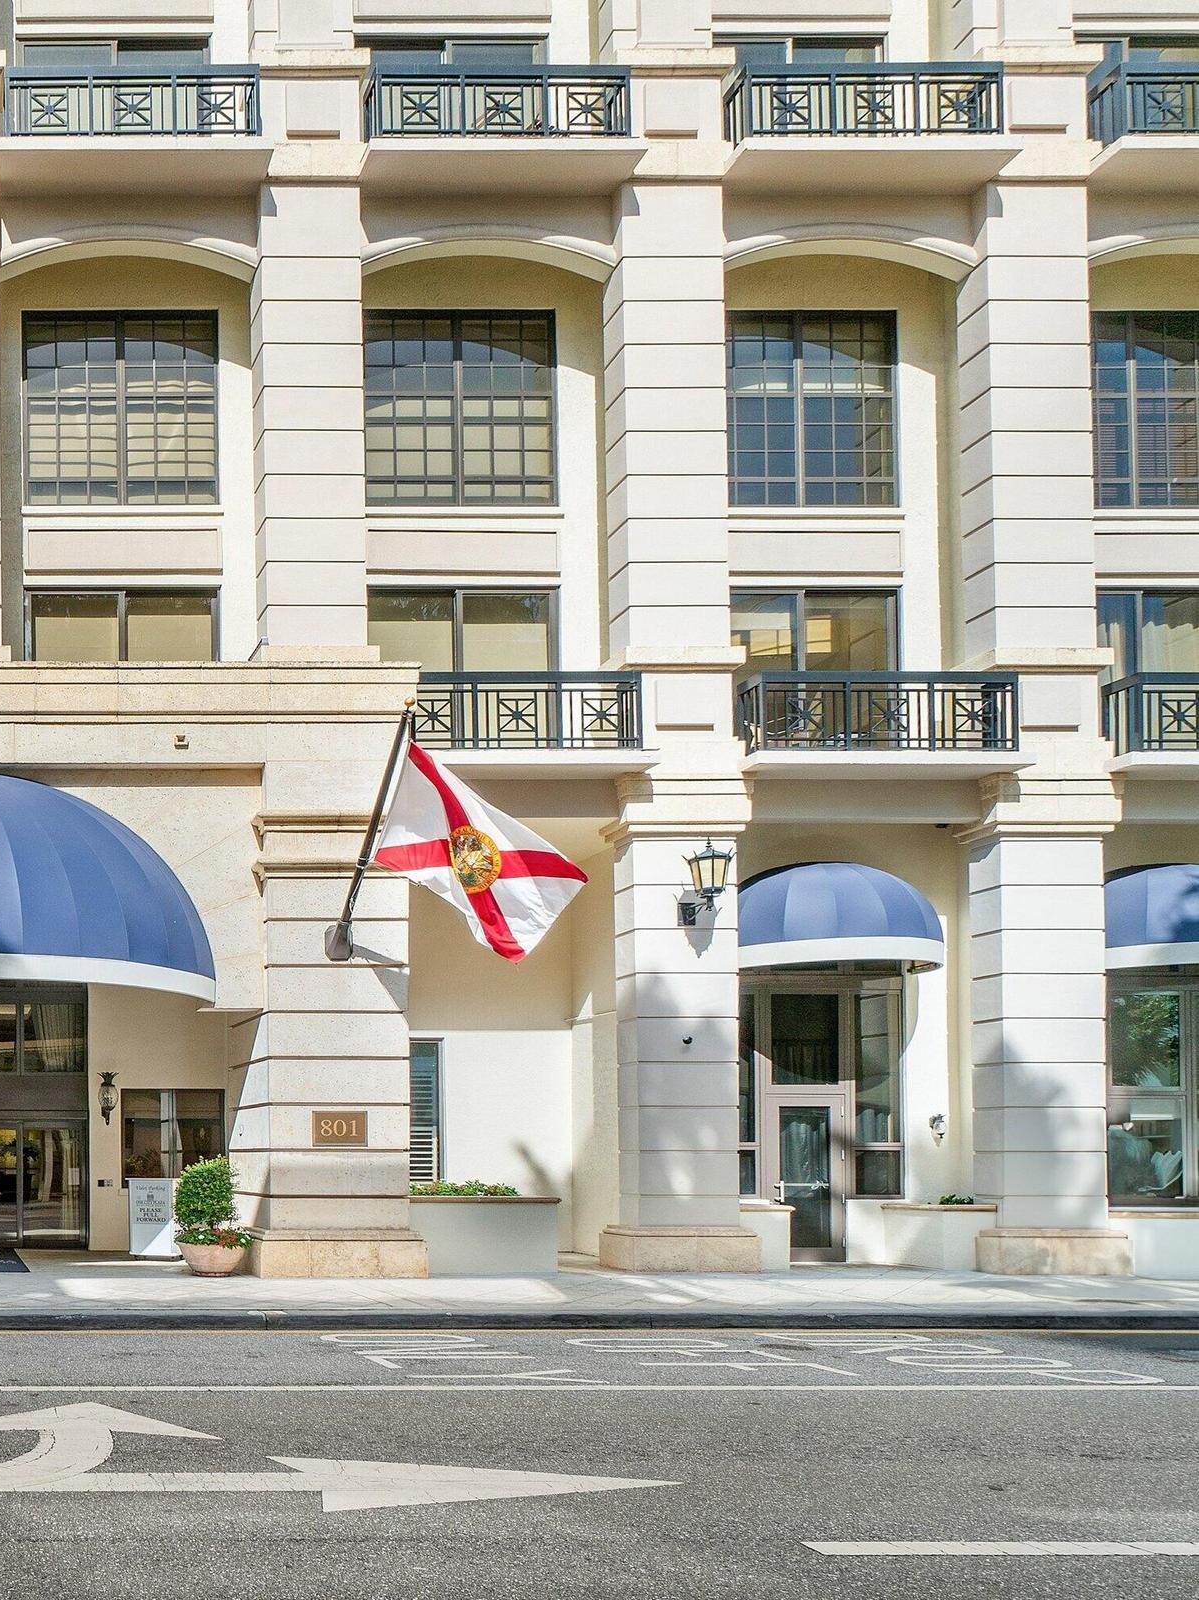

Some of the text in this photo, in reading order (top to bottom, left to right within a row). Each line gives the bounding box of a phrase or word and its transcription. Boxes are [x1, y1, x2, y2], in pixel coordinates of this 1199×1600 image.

[320, 1119, 358, 1137] 801
[319, 1333, 611, 1384] ONLY
[564, 1338, 861, 1376] OFF
[755, 1333, 1165, 1385] DROP
